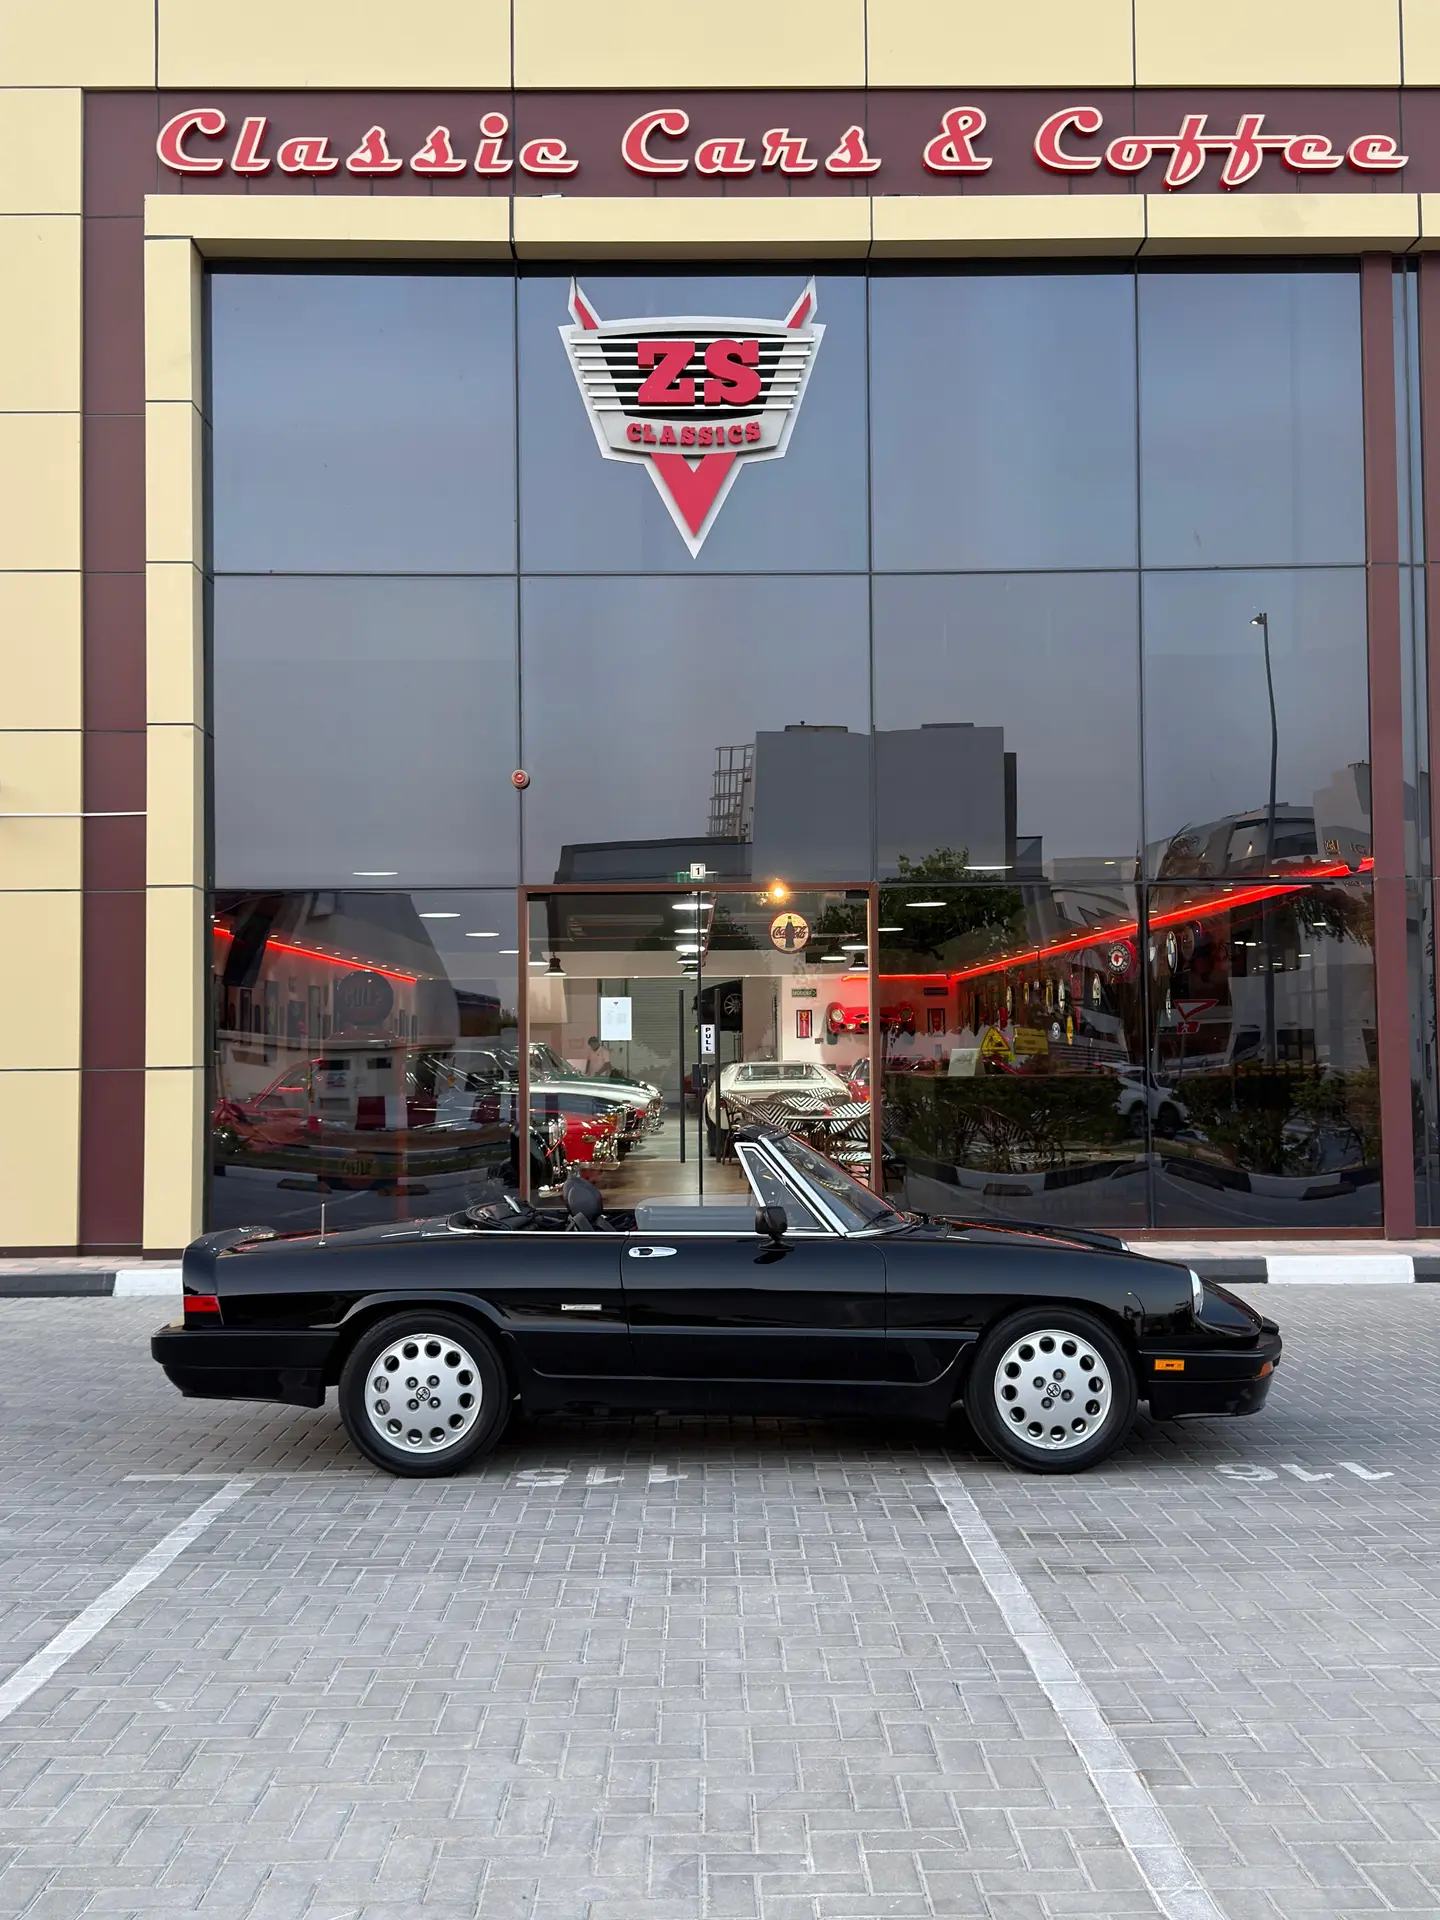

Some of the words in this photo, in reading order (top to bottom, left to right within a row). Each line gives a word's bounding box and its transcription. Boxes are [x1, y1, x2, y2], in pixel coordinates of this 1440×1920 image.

[156, 108, 579, 178] Classic
[621, 108, 882, 178] Cars
[922, 106, 993, 175] &
[1032, 106, 1409, 191] Coffee
[637, 339, 762, 407] ZS
[626, 421, 762, 446] CLASSICS
